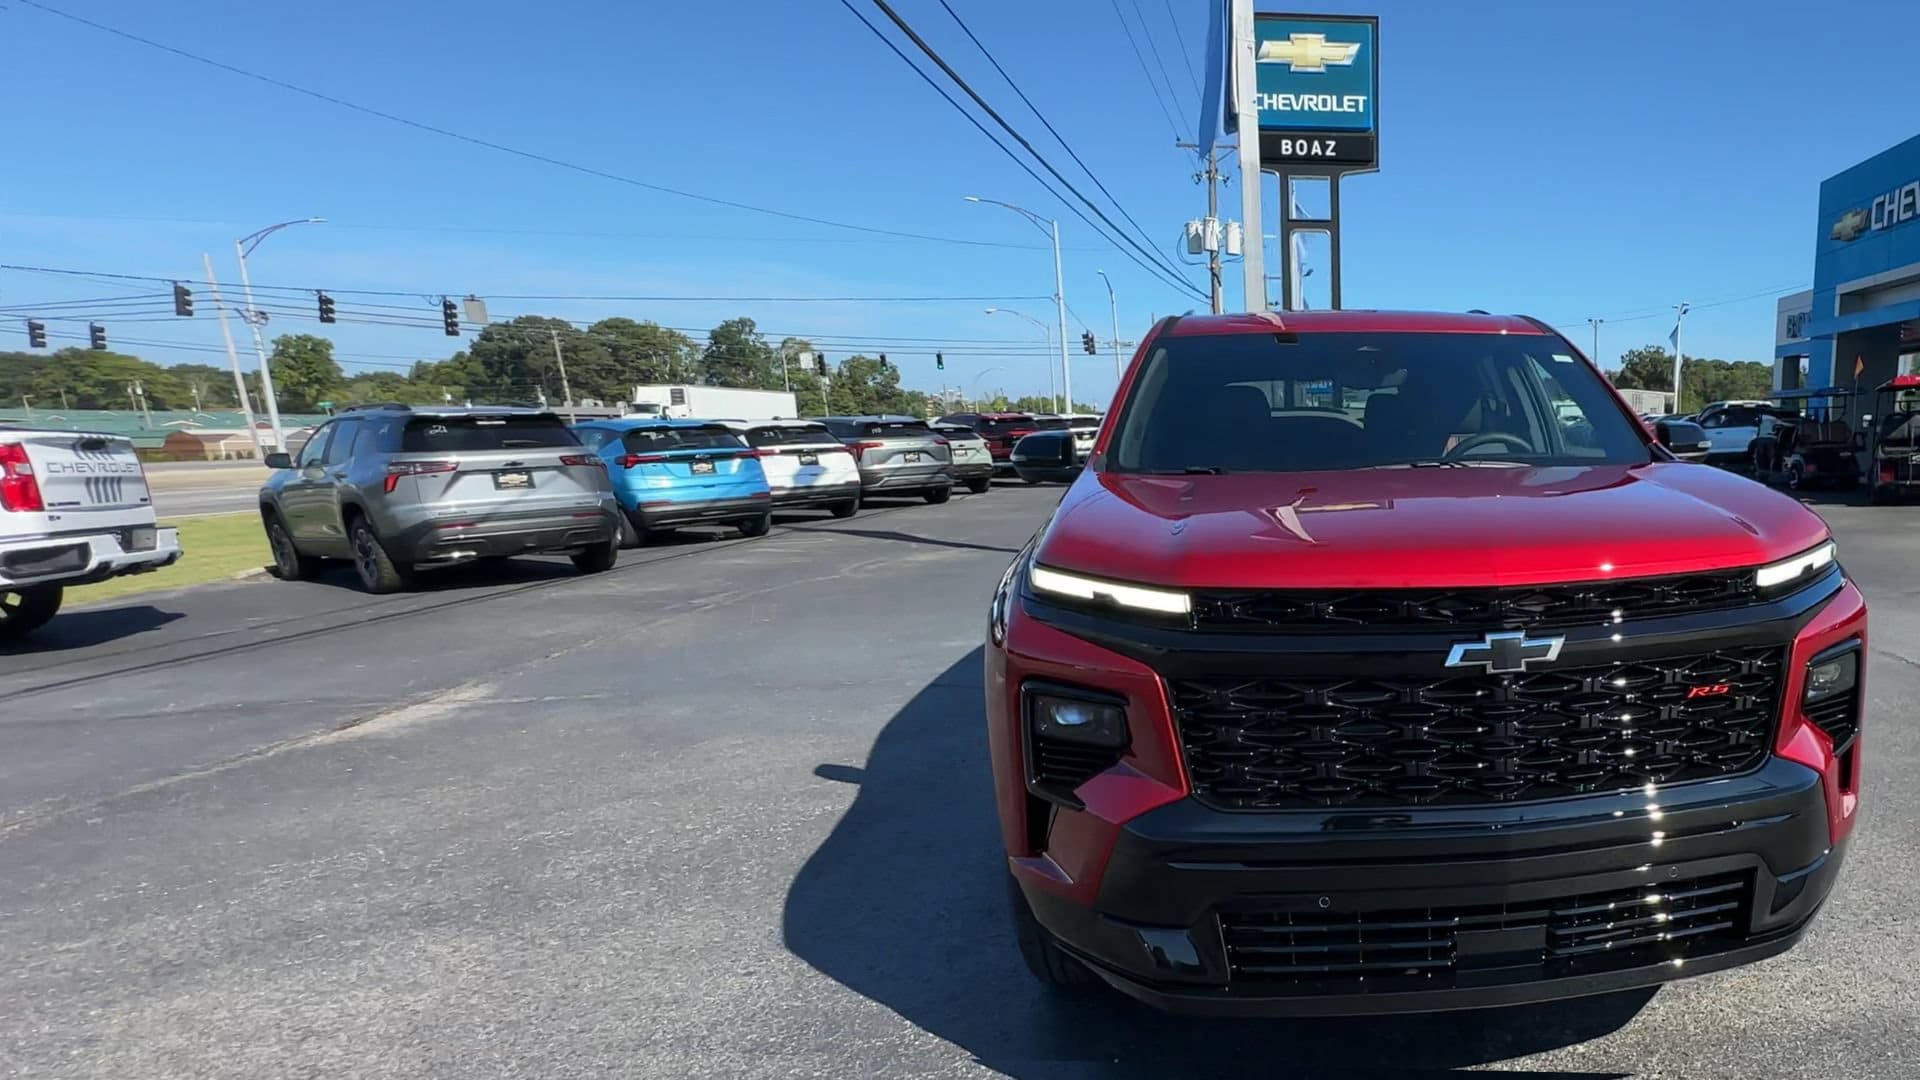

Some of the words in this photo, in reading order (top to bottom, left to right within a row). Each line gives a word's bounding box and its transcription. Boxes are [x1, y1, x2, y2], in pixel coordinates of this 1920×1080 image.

[1281, 139, 1337, 156] BOAZ
[46, 462, 139, 473] CHEVROLET
[1688, 684, 1729, 698] RS
